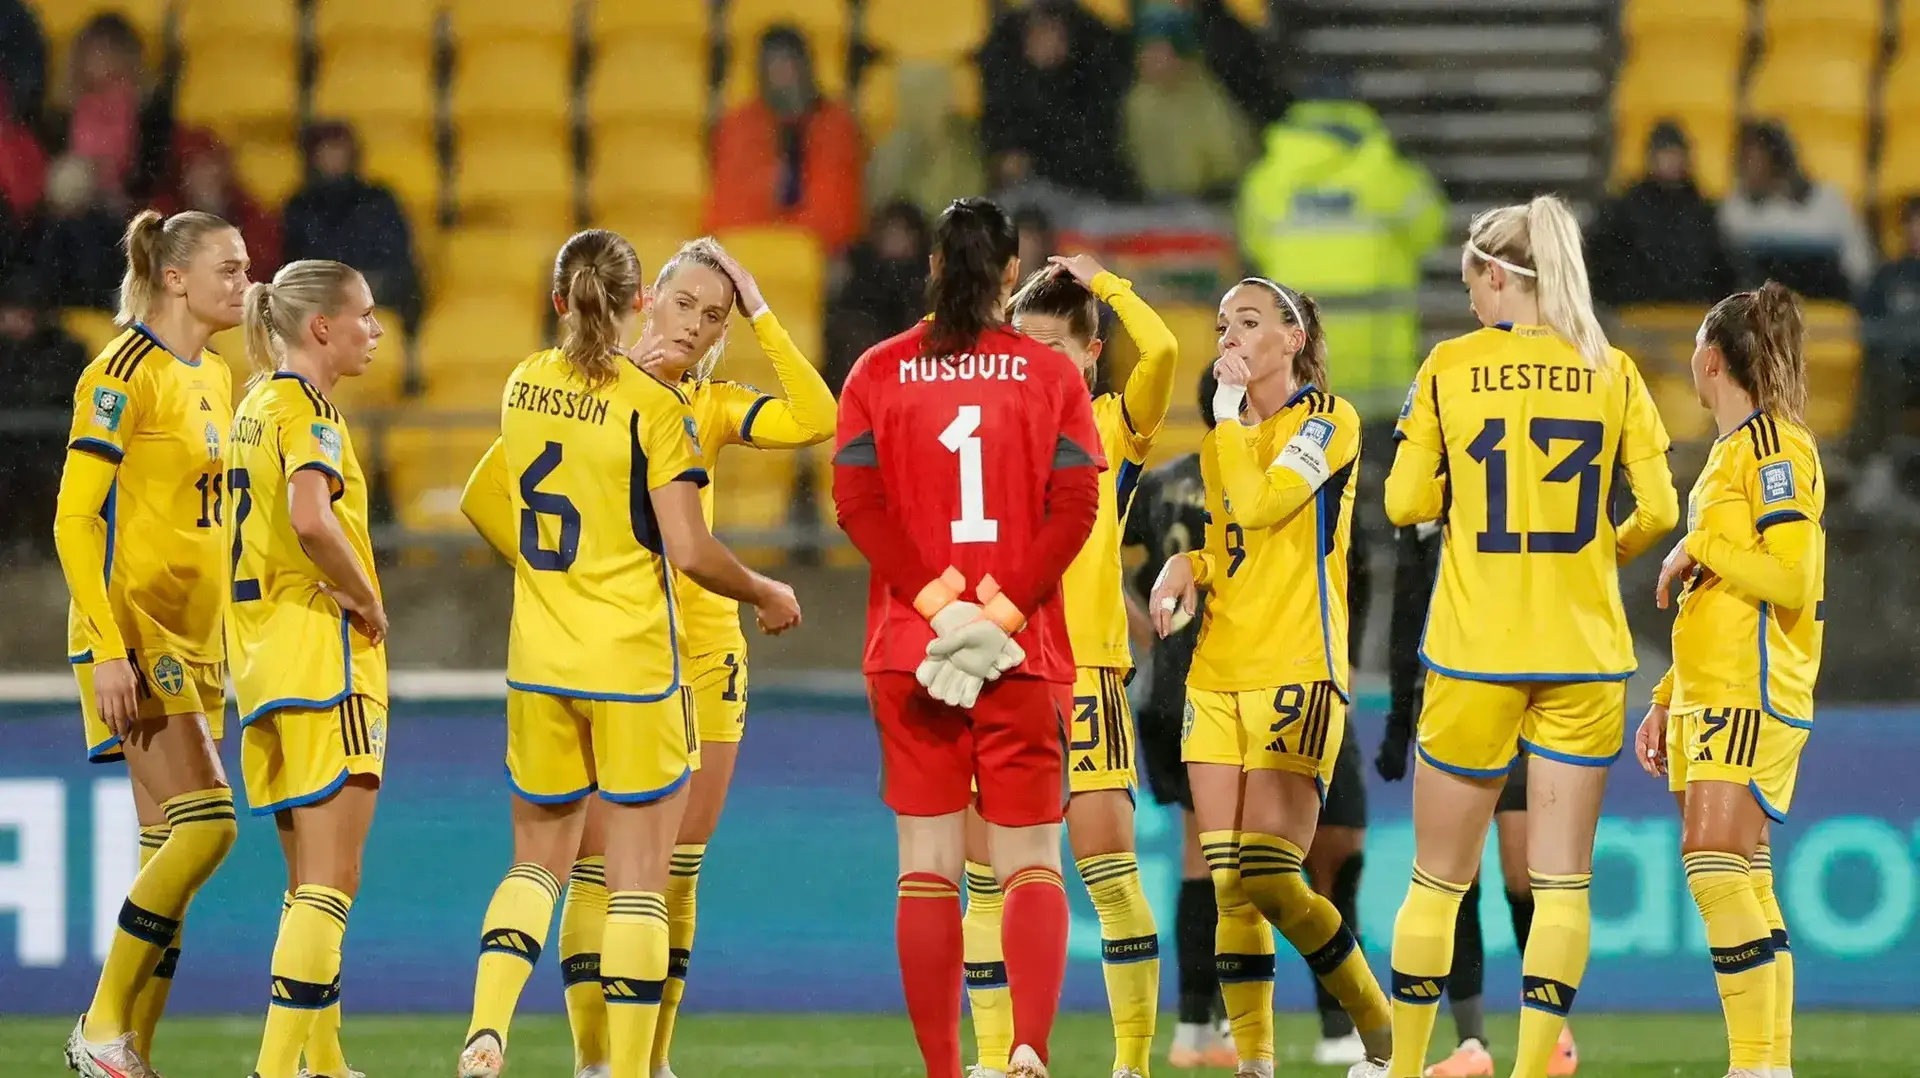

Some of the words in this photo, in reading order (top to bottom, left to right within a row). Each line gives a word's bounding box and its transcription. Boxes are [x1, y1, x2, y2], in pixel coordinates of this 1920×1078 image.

[899, 353, 1028, 384] MUSOVIC
[1471, 364, 1596, 394] ILESTEDT
[508, 381, 610, 426] ERIKSSON
[938, 405, 998, 543] 1
[1465, 417, 1604, 554] 13
[520, 440, 581, 572] 6
[1225, 523, 1246, 578] 9
[1269, 685, 1305, 732] 9
[1105, 941, 1154, 953] SVERIGE
